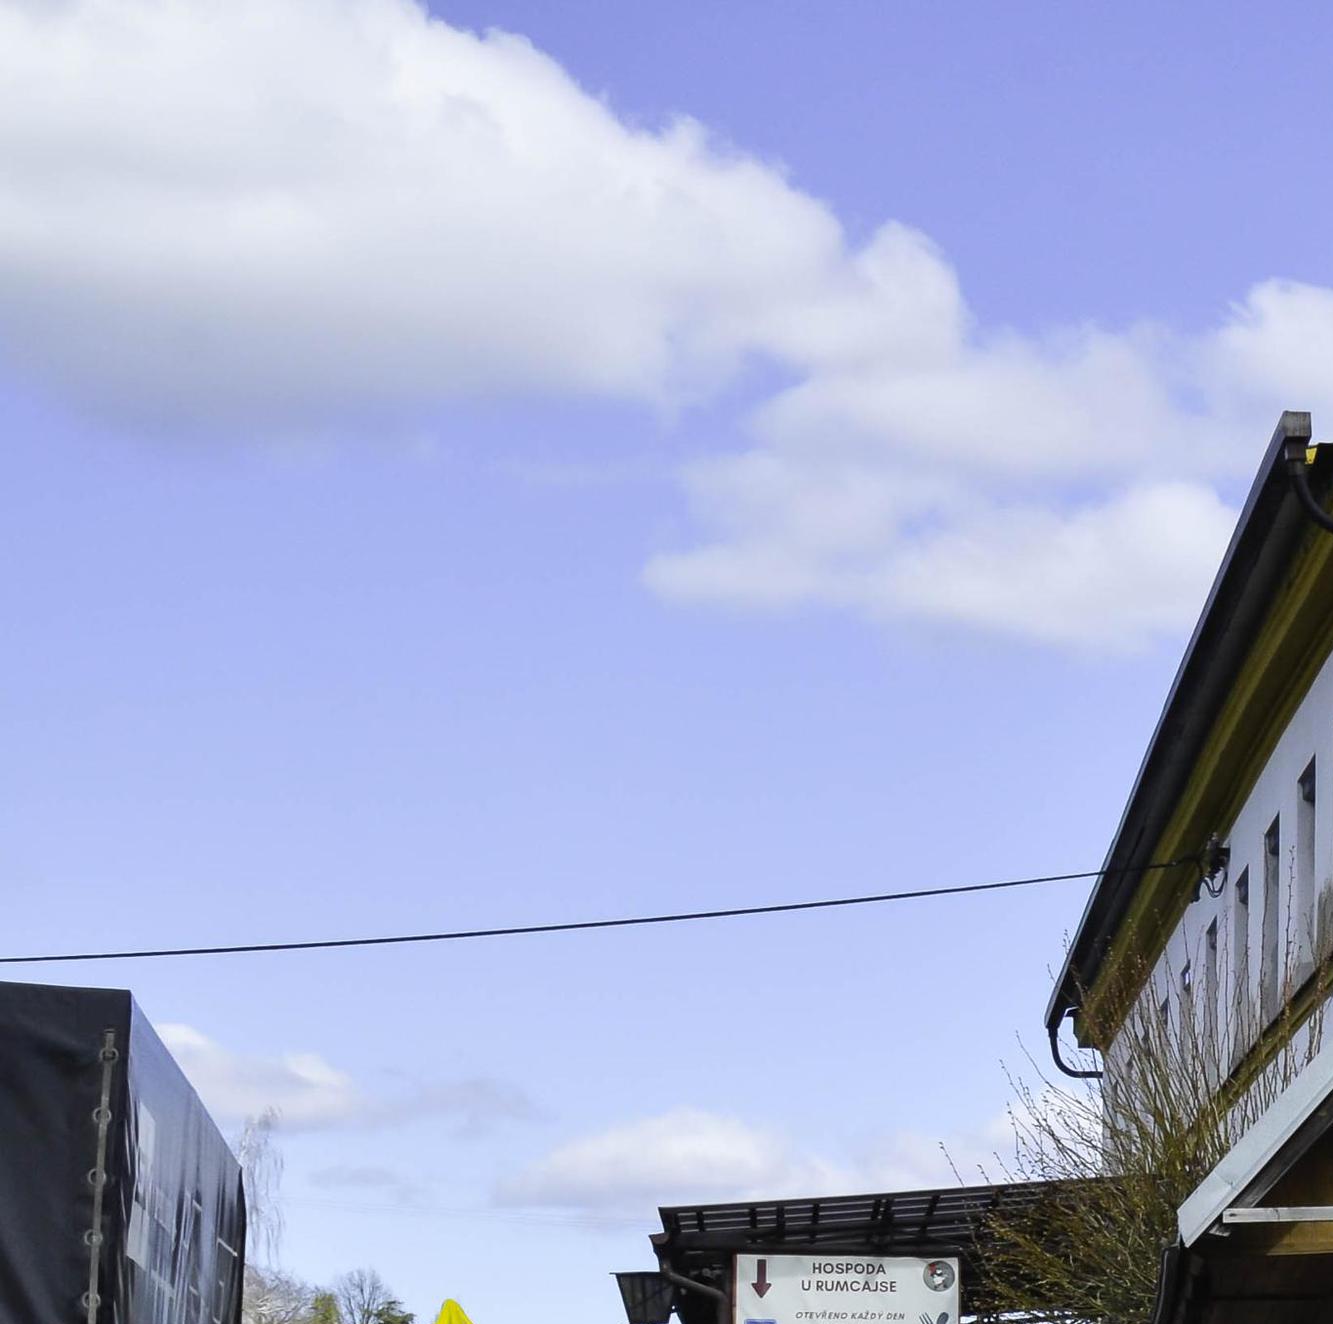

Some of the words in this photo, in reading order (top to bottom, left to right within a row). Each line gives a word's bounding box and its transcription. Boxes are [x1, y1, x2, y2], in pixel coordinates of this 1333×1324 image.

[812, 1262, 887, 1275] HOSPODA
[801, 1281, 812, 1291] U
[816, 1280, 897, 1293] RUMCAJSE
[795, 1309, 849, 1320] OTEVŘENO
[851, 1309, 884, 1320] KAŽDÝ
[886, 1311, 905, 1320] DEN
